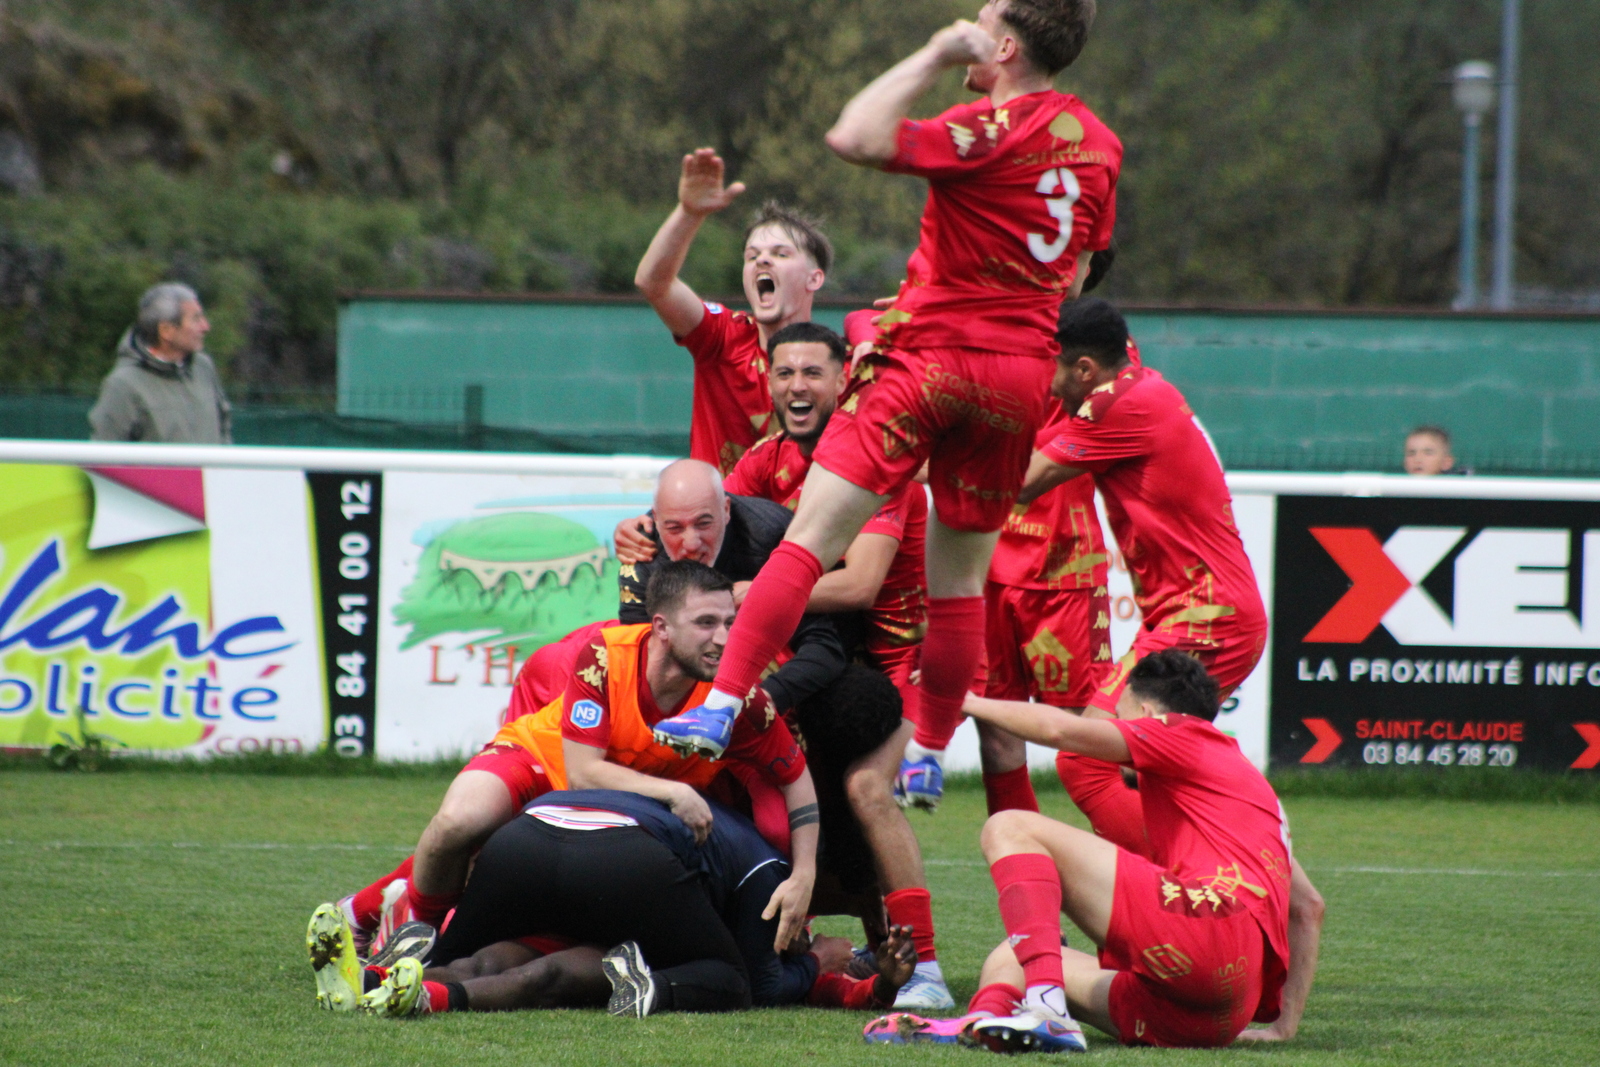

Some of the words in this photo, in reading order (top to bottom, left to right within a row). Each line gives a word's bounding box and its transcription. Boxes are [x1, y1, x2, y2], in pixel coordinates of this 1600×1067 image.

[1027, 167, 1081, 263] 3
[340, 480, 372, 520] 12
[338, 531, 370, 580] 00
[337, 593, 369, 637] 41
[334, 651, 367, 698] 84
[1298, 658, 1339, 682] LA
[1349, 656, 1523, 685] PROXIMITÉ
[575, 705, 597, 721] N3
[1355, 720, 1524, 742] SAINT-CLAUDE
[334, 714, 365, 758] 03
[1363, 741, 1392, 764] 03
[1395, 741, 1423, 765] 84
[1427, 742, 1455, 766] 45
[1457, 743, 1485, 766] 28
[1488, 744, 1518, 767] 20
